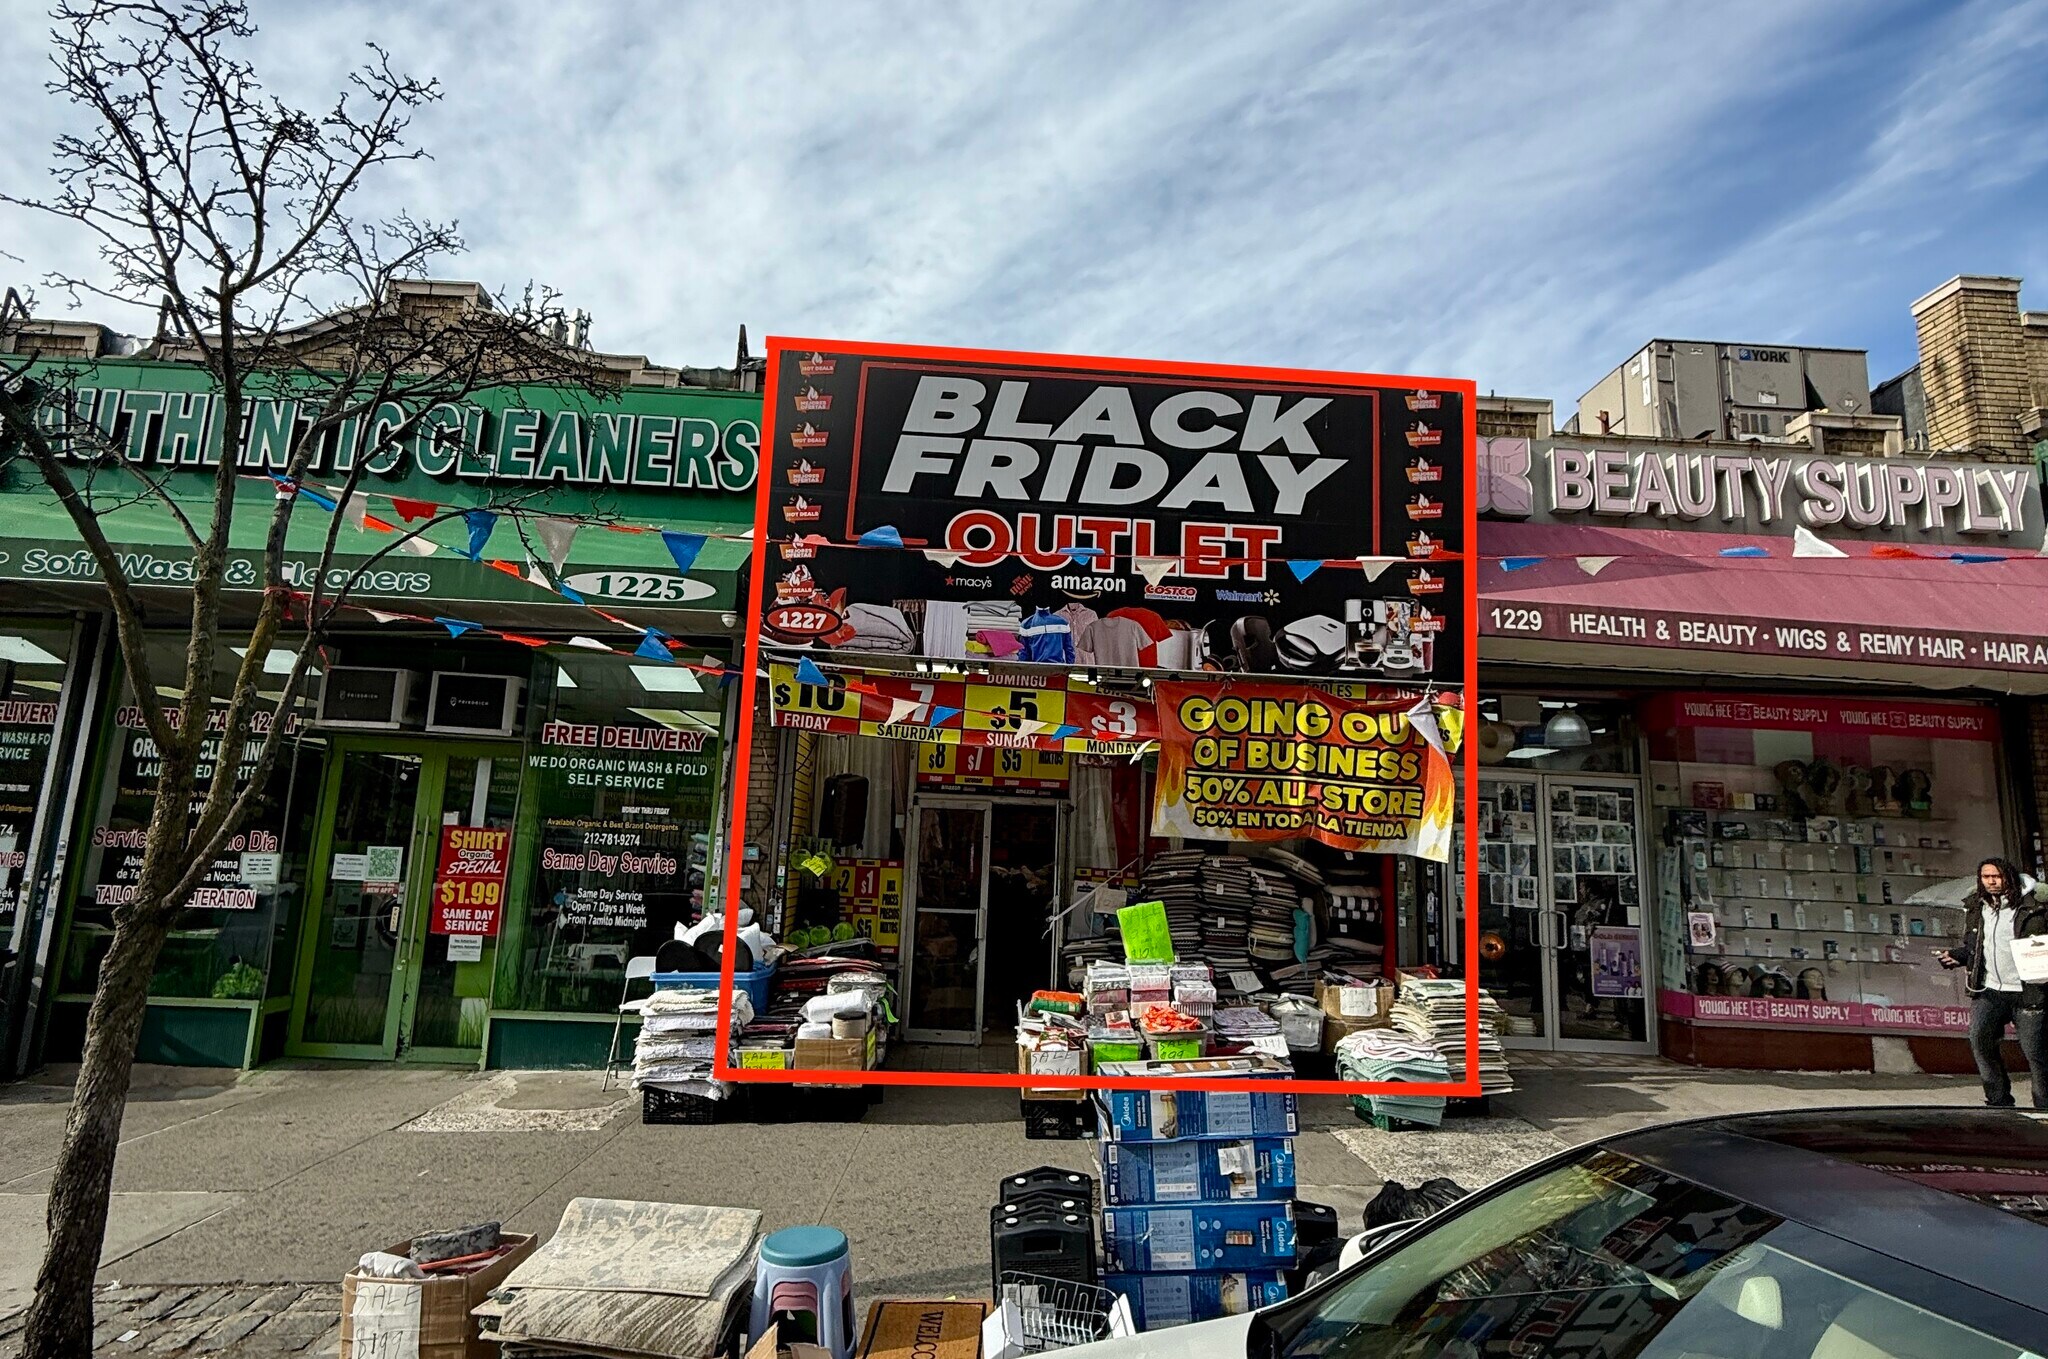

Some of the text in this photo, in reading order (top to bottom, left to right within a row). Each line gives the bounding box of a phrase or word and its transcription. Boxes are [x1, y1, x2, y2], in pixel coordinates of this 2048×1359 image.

[1751, 350, 1788, 363] YORK
[902, 375, 1334, 455] BLACK
[18, 386, 761, 491] AUTHENTIC CLEANERS
[881, 434, 1348, 515] FRIDAY
[1550, 448, 2029, 533] BEAUTY SUPPLY
[944, 508, 1282, 582] OUTLET
[226, 560, 256, 585] &
[955, 575, 992, 590] macy's
[597, 574, 685, 600] 1225
[1051, 574, 1126, 593] amazon
[1144, 583, 1197, 596] COSTCO
[1216, 589, 1263, 603] Walmart
[778, 611, 827, 630] 1227
[1491, 608, 2030, 665] 1229 HEALTH & BEAUTY WIGS & REMY HAIR HAIR
[774, 672, 846, 712] $10
[115, 705, 145, 729] OPE
[990, 691, 1038, 730] $5
[1091, 701, 1137, 738] $3
[1179, 696, 1331, 738] GOING
[1753, 706, 1791, 720] BEAUTY
[1793, 708, 1830, 722] SUPPLY
[783, 713, 831, 730] FRIDAY
[1909, 714, 1945, 728] BEAUTY
[1947, 716, 1983, 731] SUPPLY
[542, 722, 707, 752] FREE DELIVERY
[877, 723, 944, 742] SATURDAY
[986, 733, 1039, 750] SUNDAY
[929, 744, 946, 769] $8
[1087, 739, 1140, 754] MONDAY
[529, 755, 708, 776] WE DO ORGANIC WASH & FOLD
[968, 746, 983, 771] $7
[1002, 749, 1021, 773] $5
[1193, 738, 1420, 781] OF BUSINESS
[568, 773, 665, 790] SELF SERVICE
[1186, 775, 1423, 818] 50% ALL STORE
[653, 807, 670, 816] FRIDAY
[547, 818, 575, 827] Available
[577, 819, 602, 830] Organic
[603, 820, 608, 828] &
[625, 822, 644, 830] Brand
[645, 823, 679, 832] Detergents
[1195, 809, 1233, 827] 50%
[1236, 811, 1260, 827] EN
[1316, 817, 1340, 833] LA
[1345, 819, 1406, 839] TIENDA
[249, 830, 278, 852] Dia
[449, 829, 508, 851] SHIRT
[584, 832, 640, 846] 212-781-9274
[458, 849, 494, 860] Organic
[542, 848, 677, 877] Same Day Service
[116, 870, 242, 882] de Noche
[446, 860, 502, 875] SPECIAL
[441, 879, 500, 906] $1.99
[577, 888, 642, 902] Same Day Service
[442, 908, 494, 921] SAME DAY
[572, 901, 591, 914] Open
[592, 902, 598, 912] 7
[599, 902, 618, 914] Days
[625, 904, 646, 915] Week
[445, 919, 489, 932] SERVICE
[567, 914, 586, 925] From
[614, 916, 647, 930] Midnight
[1699, 1000, 1850, 1020] YOUNG HEE BEAUTY SUPPLY
[1872, 1008, 1922, 1024] YOUNG HEE
[744, 1051, 779, 1064] SALE
[1032, 1051, 1072, 1066] SALE
[1121, 1096, 1132, 1126] Midea
[1276, 1221, 1287, 1252] Midea
[356, 1284, 422, 1320] SALE
[911, 1309, 944, 1359] WELCO
